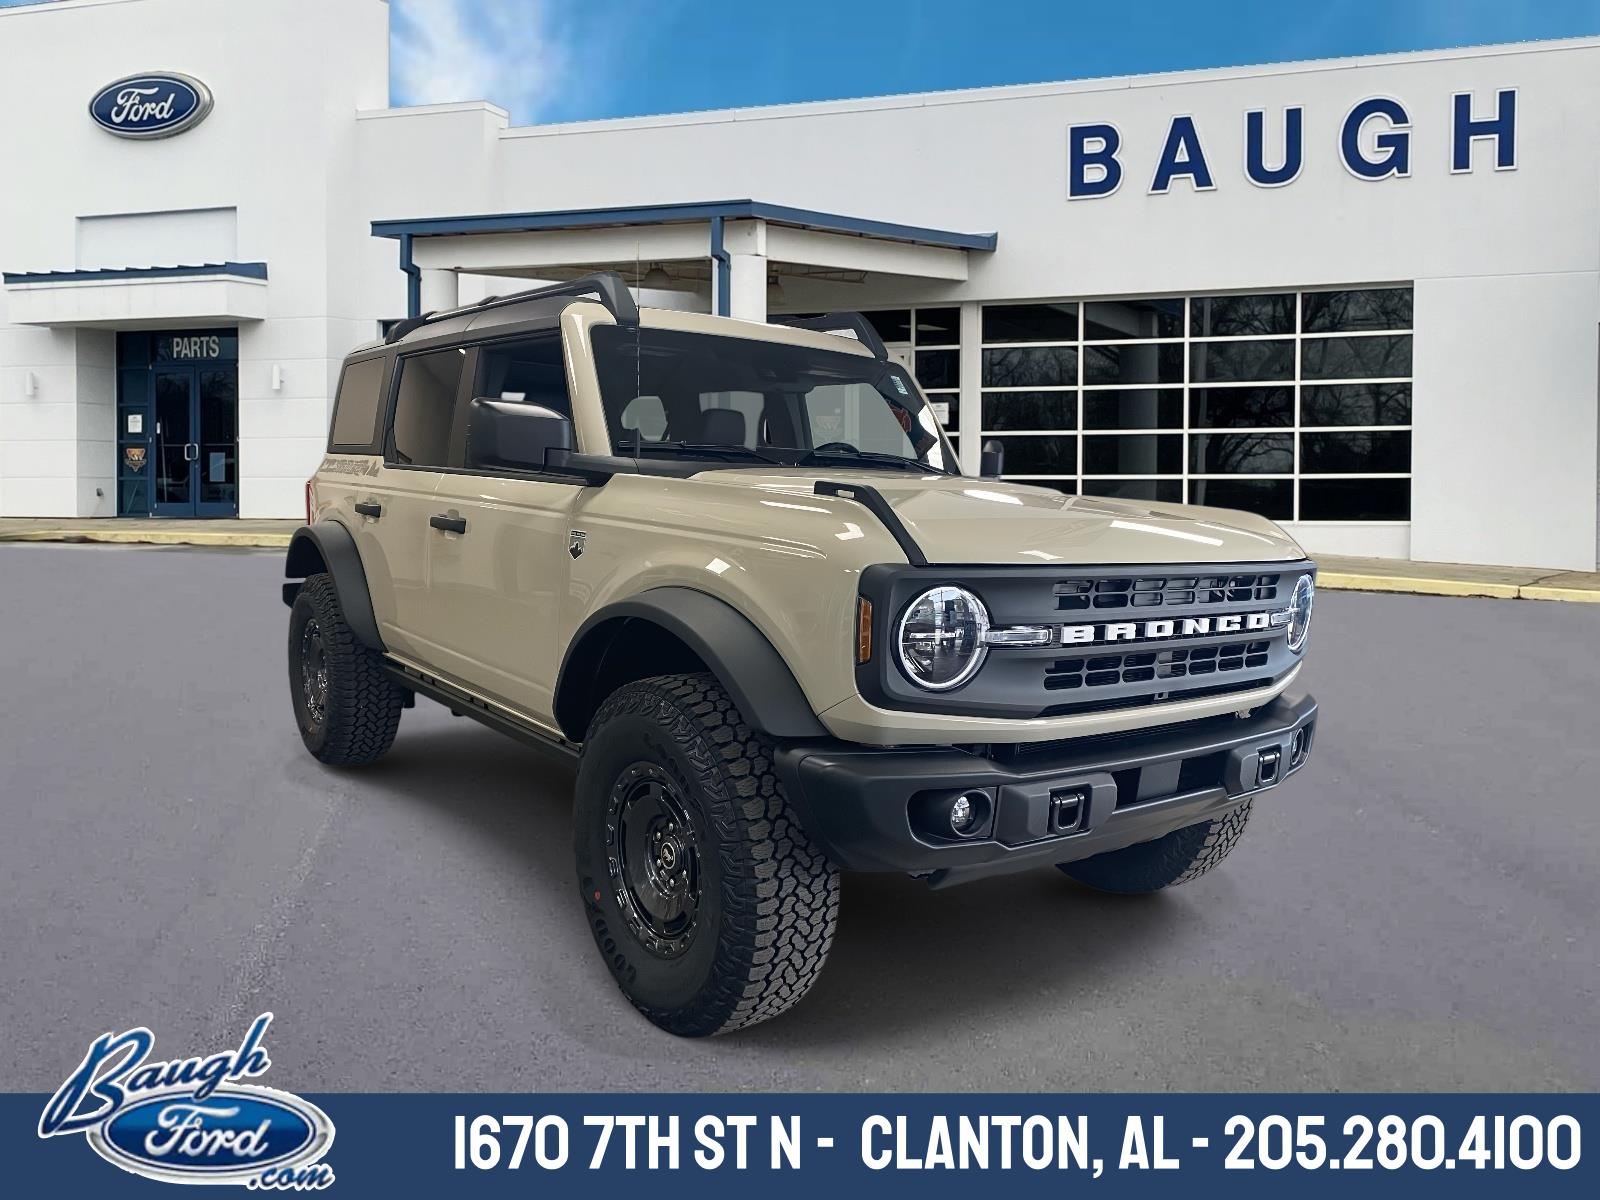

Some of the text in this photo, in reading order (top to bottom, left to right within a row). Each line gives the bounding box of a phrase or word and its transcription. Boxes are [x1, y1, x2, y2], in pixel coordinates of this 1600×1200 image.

[111, 87, 175, 123] Ford
[1067, 87, 1518, 200] BAUGH
[173, 336, 220, 358] PARTS
[1061, 613, 1270, 643] BRONCO
